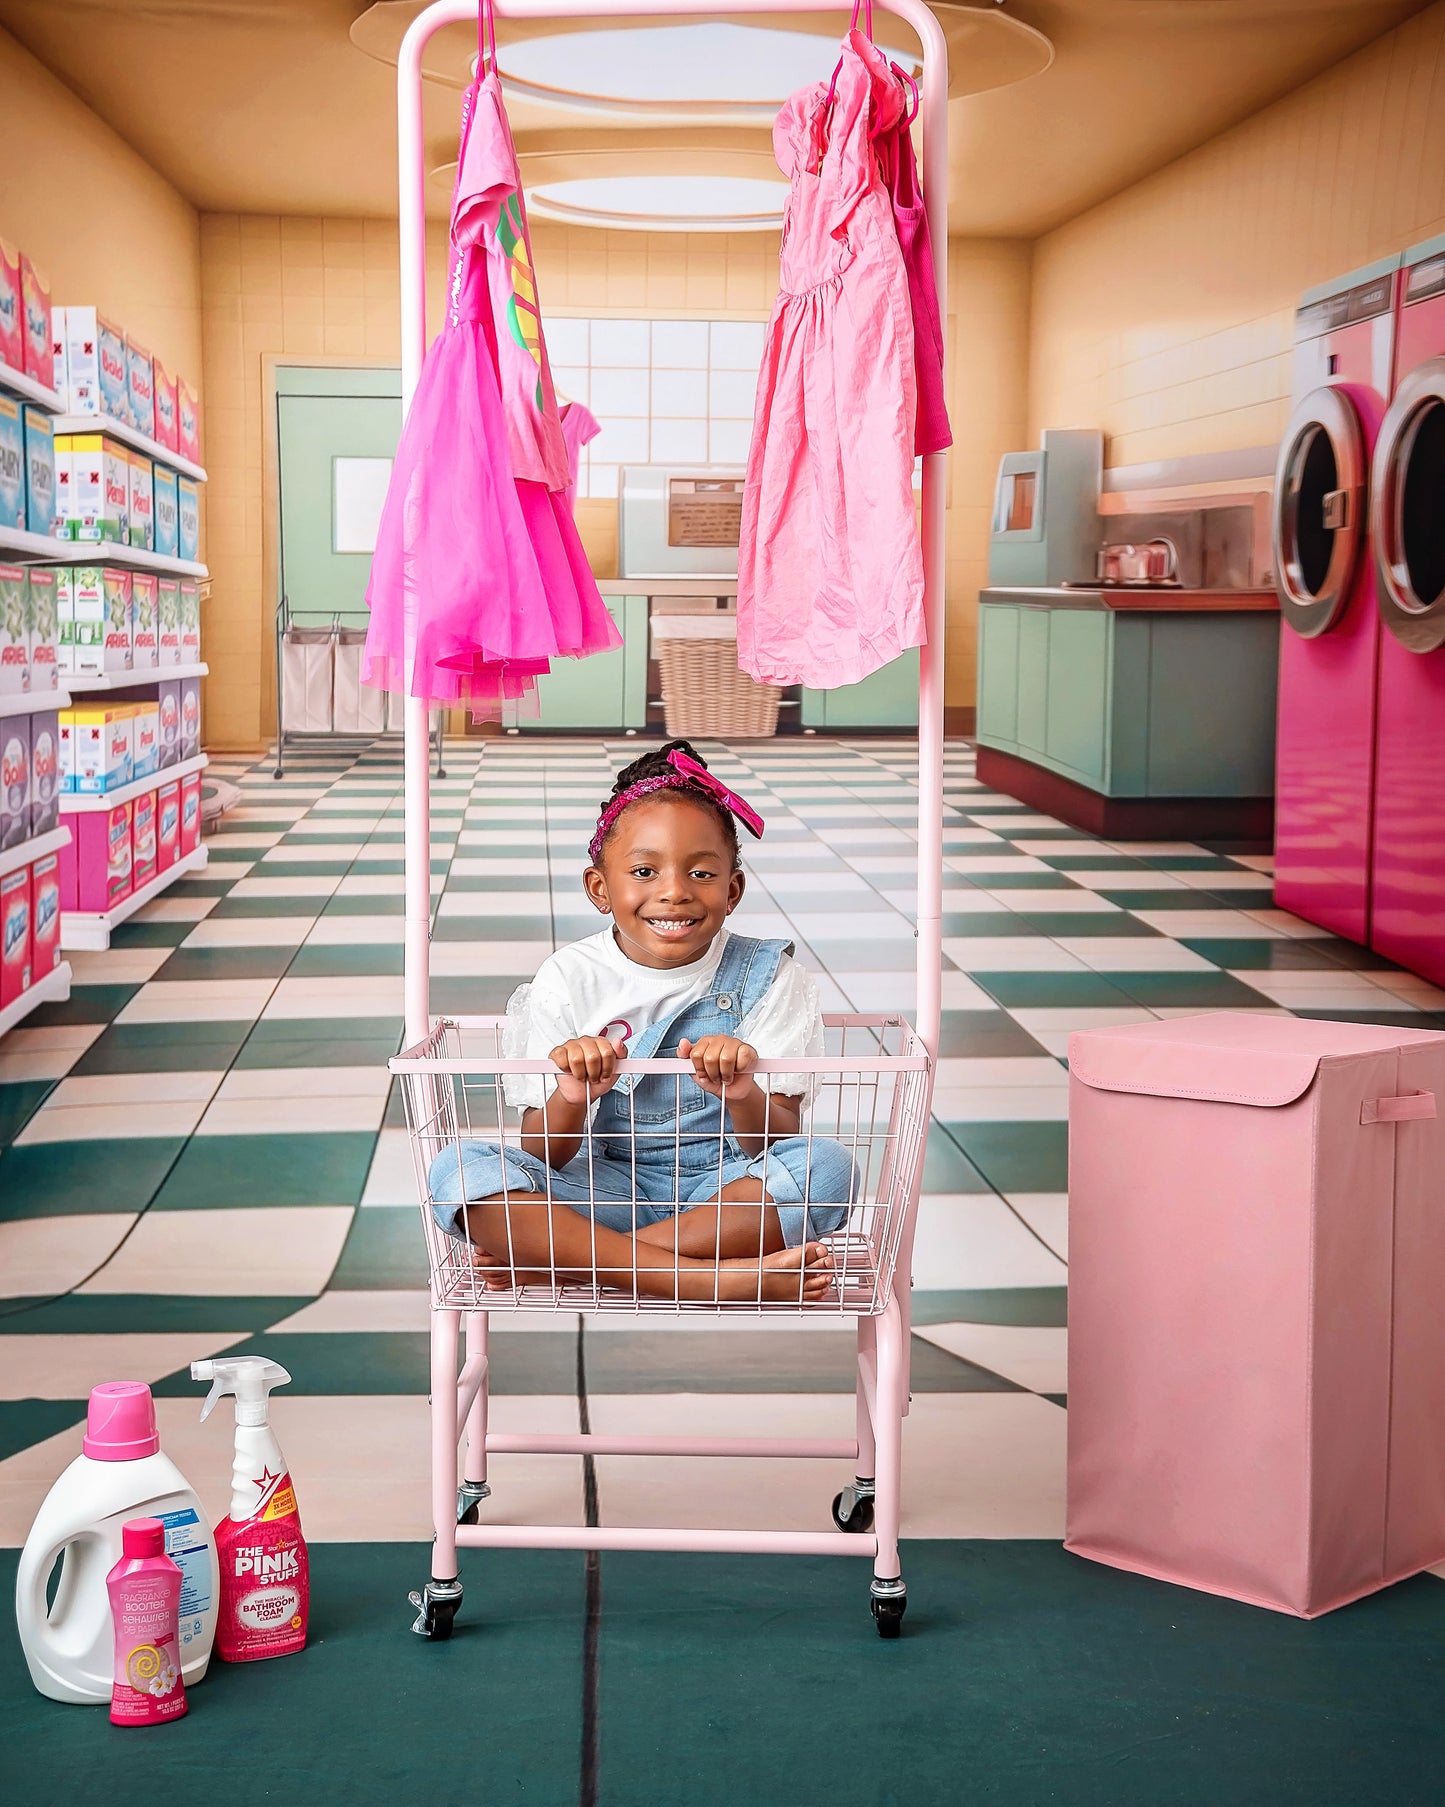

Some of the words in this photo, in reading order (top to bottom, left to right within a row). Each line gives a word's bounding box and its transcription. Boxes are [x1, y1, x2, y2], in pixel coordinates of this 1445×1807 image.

[236, 1546, 264, 1557] THE
[235, 1547, 299, 1577] PINK
[260, 1566, 299, 1585] STUFF
[243, 1596, 295, 1613] BATHROOM
[264, 1595, 286, 1603] MIRACLE
[257, 1606, 284, 1618] FOAM
[260, 1614, 282, 1622] CLEANER
